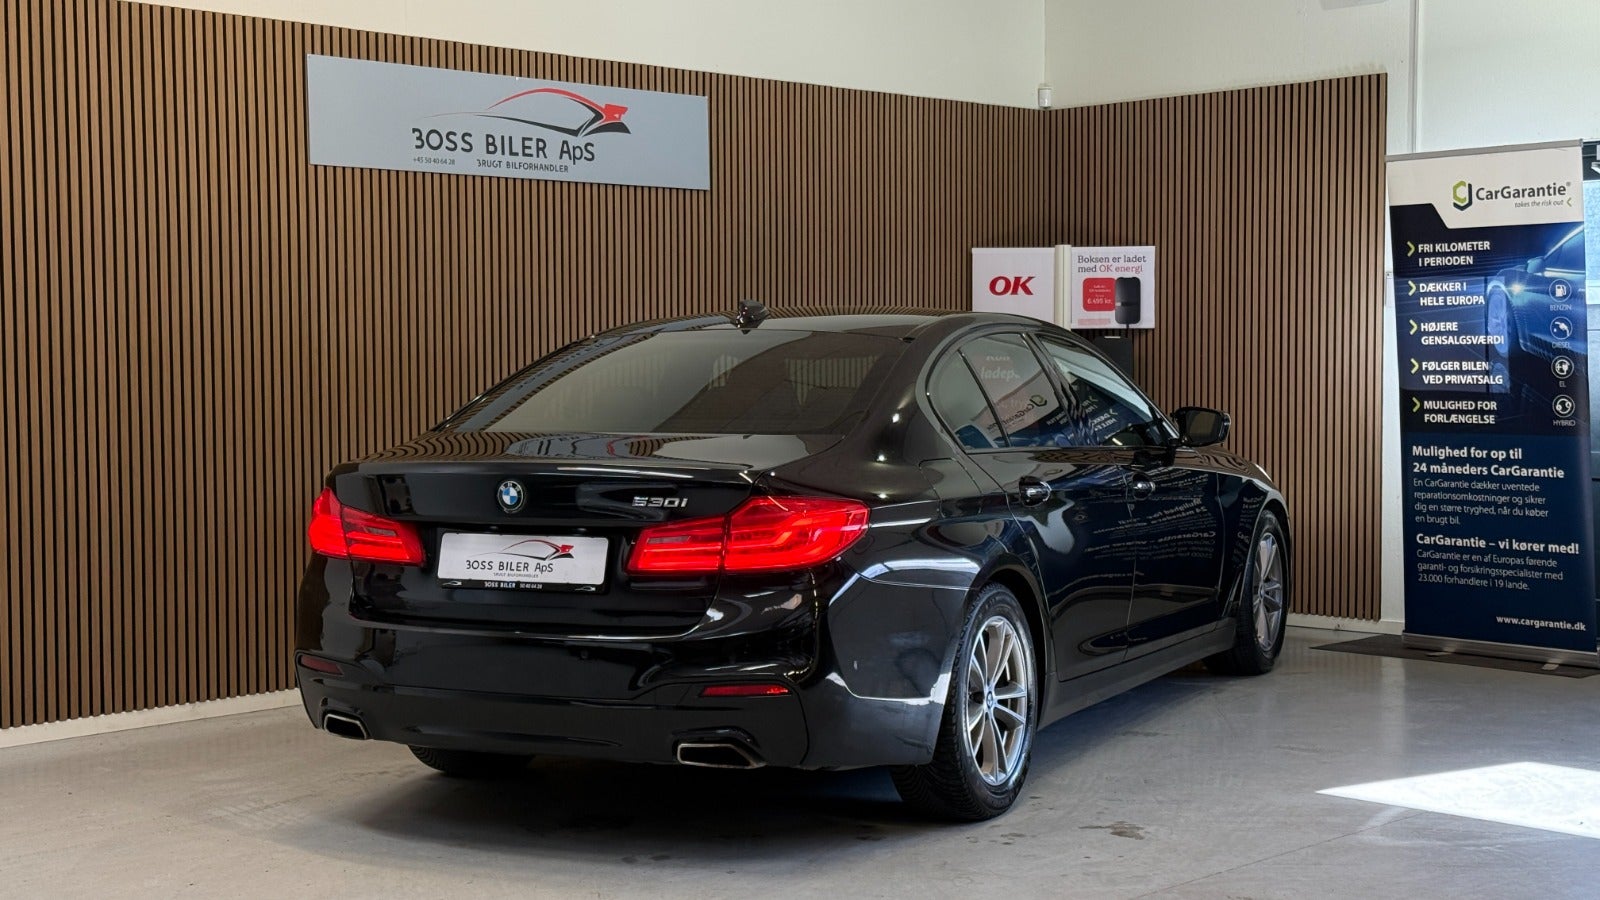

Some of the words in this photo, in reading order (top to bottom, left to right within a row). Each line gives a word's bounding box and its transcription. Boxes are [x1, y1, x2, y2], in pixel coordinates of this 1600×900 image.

[486, 134, 548, 159] BILER
[559, 140, 595, 165] ApS
[506, 161, 568, 172] BILFORHANDLER
[1418, 244, 1433, 253] FRI
[1436, 241, 1490, 253] KILOMETER
[1078, 255, 1110, 263] Boksen
[1124, 255, 1146, 263] ladet
[1419, 259, 1422, 267] I
[1424, 256, 1474, 266] PERIODEN
[1115, 265, 1143, 274] energi
[989, 276, 1035, 296] OK
[1420, 283, 1461, 292] DÆKKER
[1463, 283, 1466, 291] I
[1420, 297, 1444, 306] HELE
[1446, 296, 1485, 306] EUROPA
[1421, 322, 1458, 332] HØJERE
[1421, 336, 1504, 345] GENSALGSVÆRDI
[1422, 361, 1460, 371] FØLGER
[1462, 361, 1489, 371] BILEN
[1422, 375, 1443, 384] VED
[1445, 375, 1503, 384] PRIVATSALG
[1424, 400, 1475, 410] MULIGHED
[1478, 401, 1497, 410] FOR
[1424, 414, 1495, 424] FORLÆNGELSE
[1412, 445, 1468, 460] Mulighed
[1470, 446, 1486, 458] for
[1490, 449, 1506, 461] op
[1509, 448, 1522, 460] til
[1413, 463, 1427, 472] 24
[1430, 463, 1488, 475] måneders
[1490, 465, 1564, 478] CarGarantie
[1425, 479, 1469, 489] CarGarantie
[1471, 480, 1500, 490] dækker
[1502, 483, 1540, 492] uventede
[1414, 491, 1510, 503] reparationsomkostninger
[1512, 496, 1522, 504] og
[1524, 495, 1546, 504] sikrer
[1414, 502, 1426, 512] dig
[1464, 505, 1496, 516] tryghed,
[1498, 507, 1511, 516] når
[1512, 507, 1524, 516] du
[1525, 508, 1548, 517] køber
[1427, 514, 1448, 525] brugt
[1450, 515, 1460, 525] bil.
[1416, 533, 1486, 548] CarGarantie
[1498, 539, 1509, 549] vi
[1512, 540, 1544, 552] kører
[1548, 542, 1579, 554] med!
[1417, 550, 1461, 560] CarGarantie
[1484, 553, 1491, 562] af
[1493, 555, 1524, 566] Europas
[1526, 557, 1558, 568] førende
[499, 561, 529, 572] BILER
[534, 563, 554, 574] ApS
[1417, 562, 1446, 572] garanti-
[1448, 565, 1458, 574] og
[1460, 565, 1542, 579] forsikringsspecialister
[1544, 570, 1563, 580] med
[1418, 574, 1442, 582] 23.000
[1444, 575, 1488, 586] forhandlere
[1494, 579, 1504, 587] 19
[1505, 580, 1530, 590] lande.
[1496, 616, 1586, 631] www.cargarantie.dk
